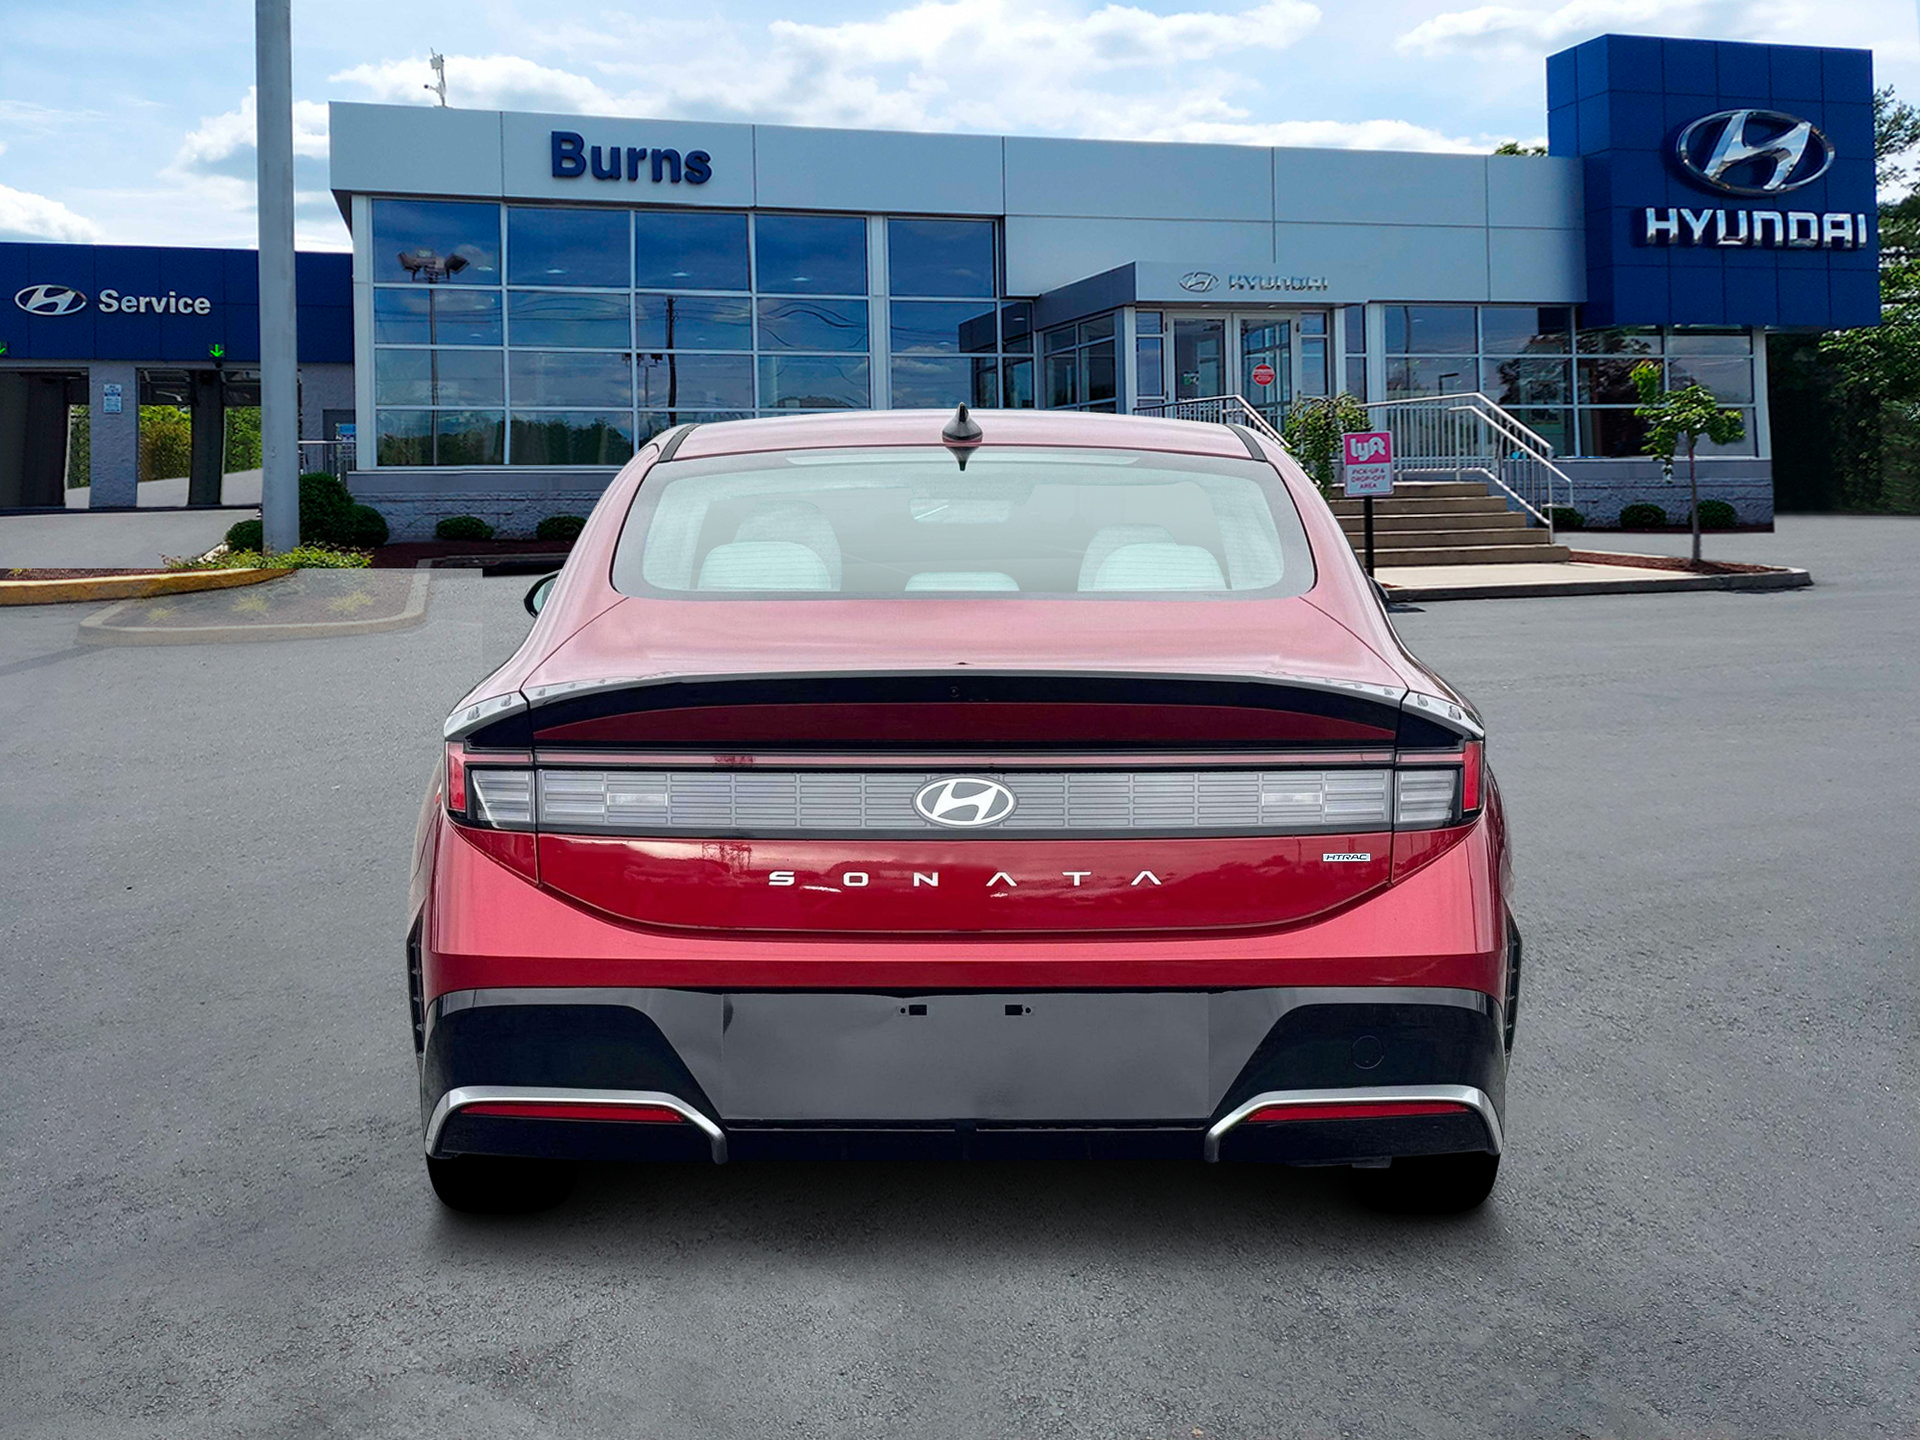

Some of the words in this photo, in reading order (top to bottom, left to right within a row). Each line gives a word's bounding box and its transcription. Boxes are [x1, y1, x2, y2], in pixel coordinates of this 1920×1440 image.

[551, 130, 713, 185] Burns
[1645, 207, 1868, 248] HYUNDAI
[1228, 274, 1329, 291] HYUNDAI
[98, 289, 212, 315] Service
[1350, 436, 1386, 462] lyft
[768, 870, 1162, 887] SONATA
